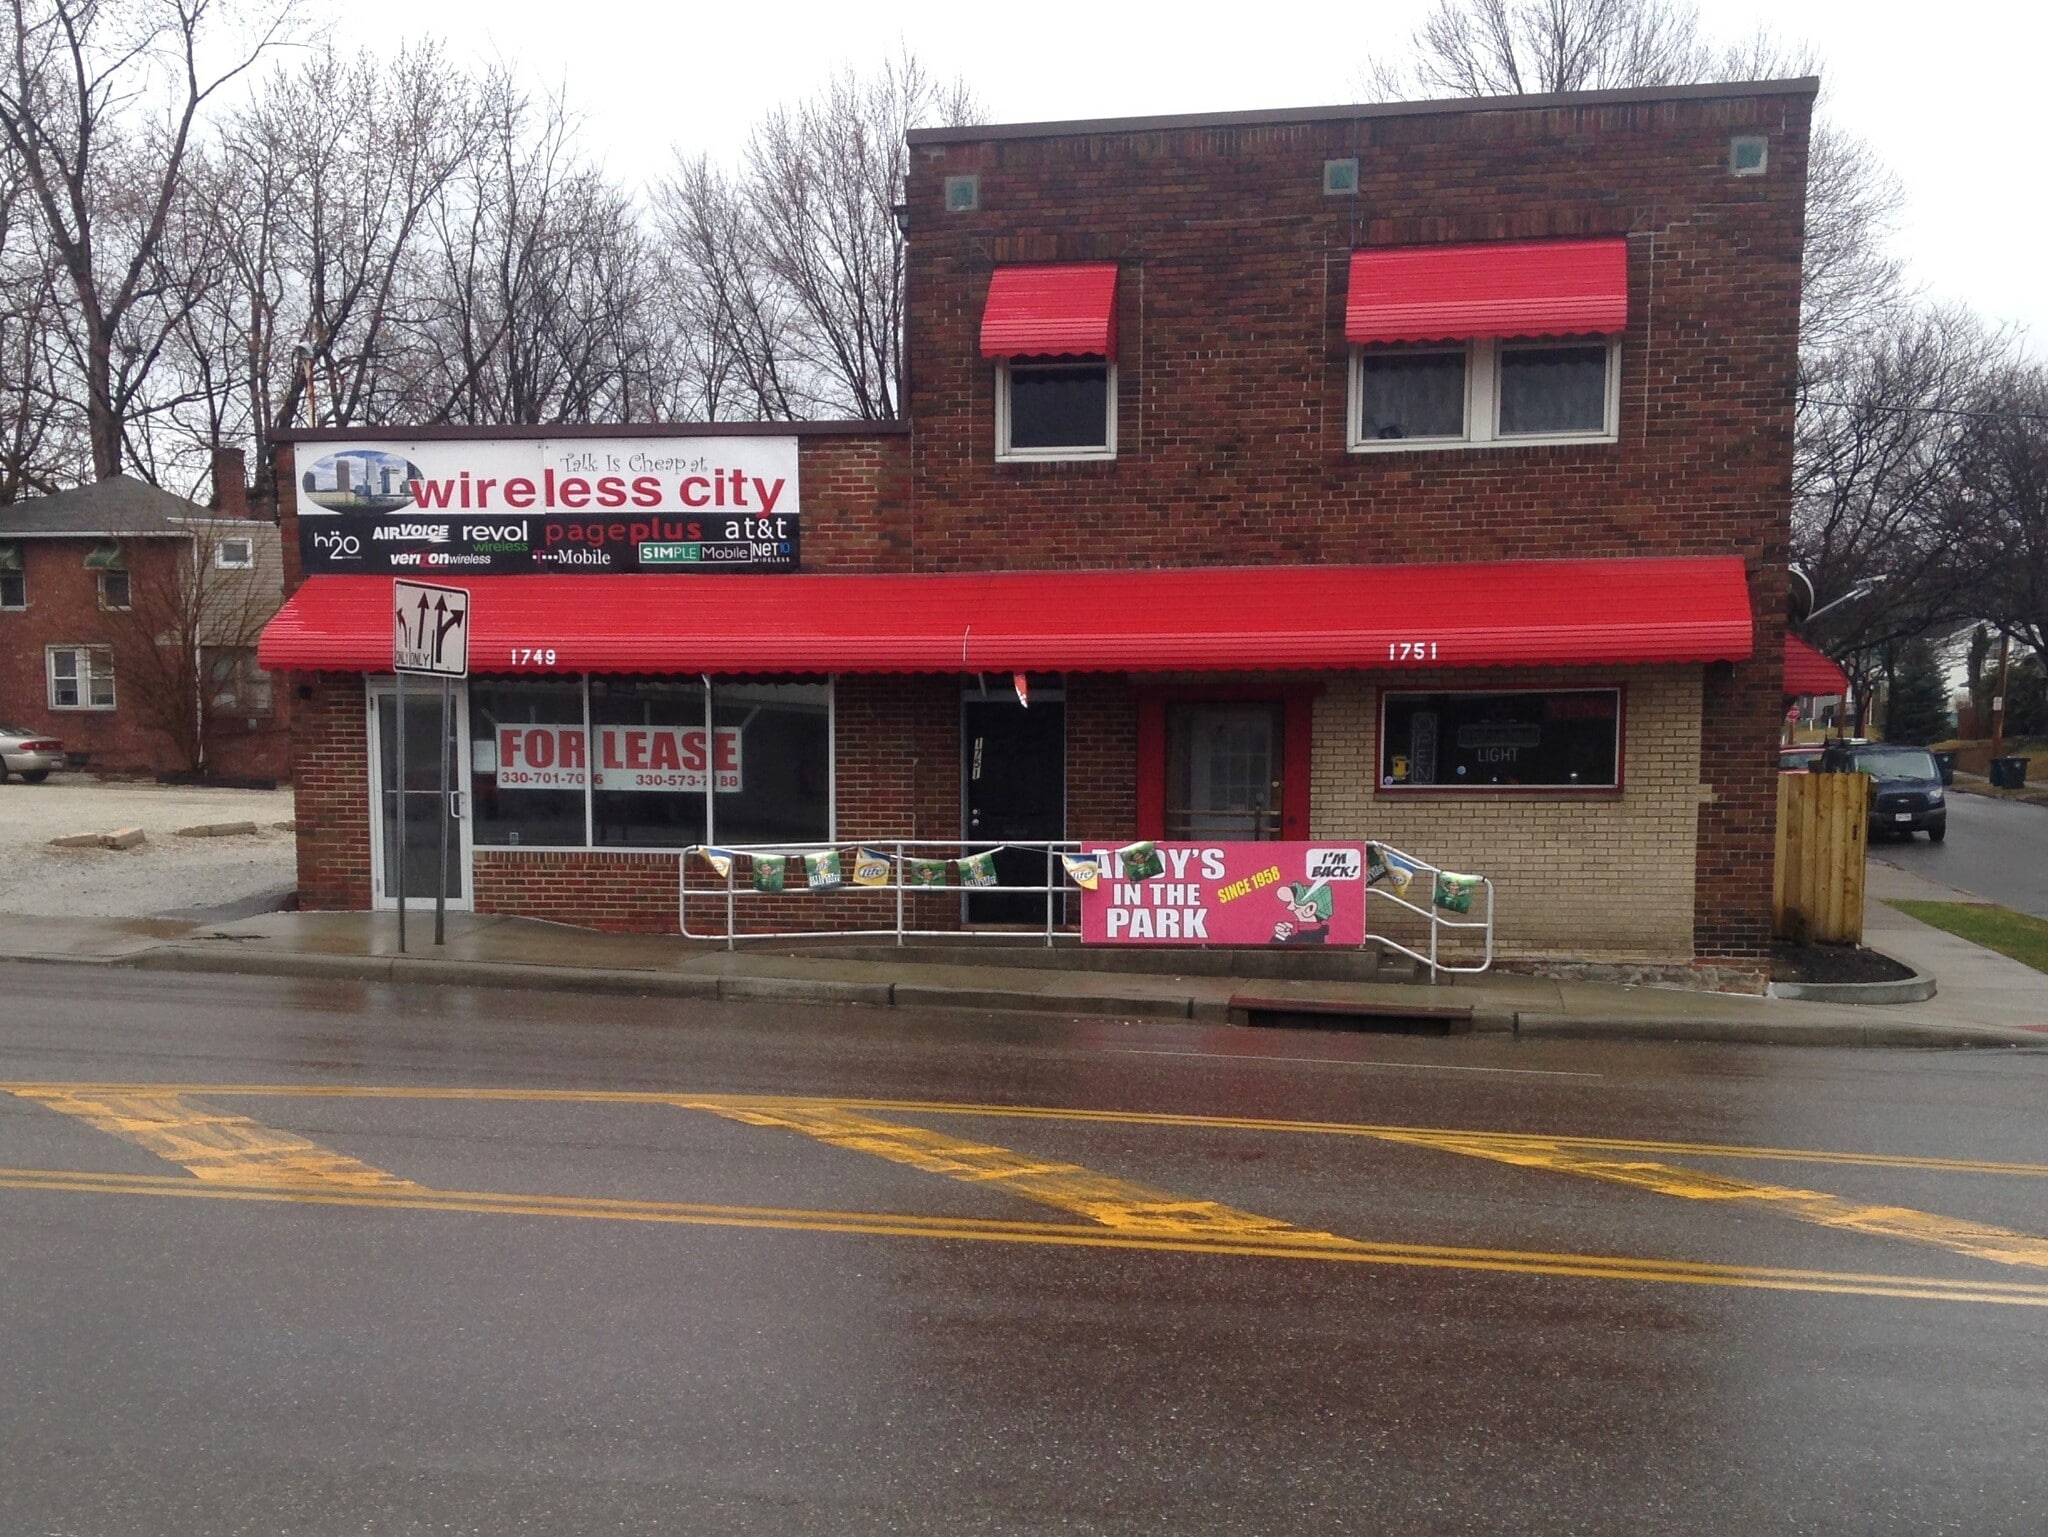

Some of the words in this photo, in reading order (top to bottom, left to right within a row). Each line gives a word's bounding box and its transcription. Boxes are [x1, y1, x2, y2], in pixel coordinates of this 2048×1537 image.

[560, 453, 598, 472] Talk
[605, 454, 621, 471] Is
[628, 454, 686, 475] Cheap
[690, 456, 708, 472] at
[410, 468, 662, 508] wireless
[679, 468, 786, 518] city
[462, 520, 529, 541] revol
[545, 518, 702, 547] pageplus
[725, 517, 788, 541] at&t
[473, 541, 529, 552] wireless
[643, 546, 697, 560] SIMPLE
[702, 544, 748, 559] Mobile
[449, 554, 491, 565] wireless
[410, 653, 430, 667] ONLY
[510, 649, 556, 665] 1749
[1389, 642, 1437, 661] 1751
[501, 729, 584, 768] FOR
[603, 731, 738, 771] LEASE
[1477, 748, 1518, 762] LIGHT
[501, 772, 603, 786] 330-701-706
[1321, 852, 1347, 864] I'M
[1311, 866, 1359, 878] BACK!
[1113, 884, 1141, 905] IN
[1149, 884, 1200, 905] THE
[1217, 884, 1252, 904] SINCE
[1251, 866, 1281, 889] 1958
[1107, 908, 1208, 938] PARK
